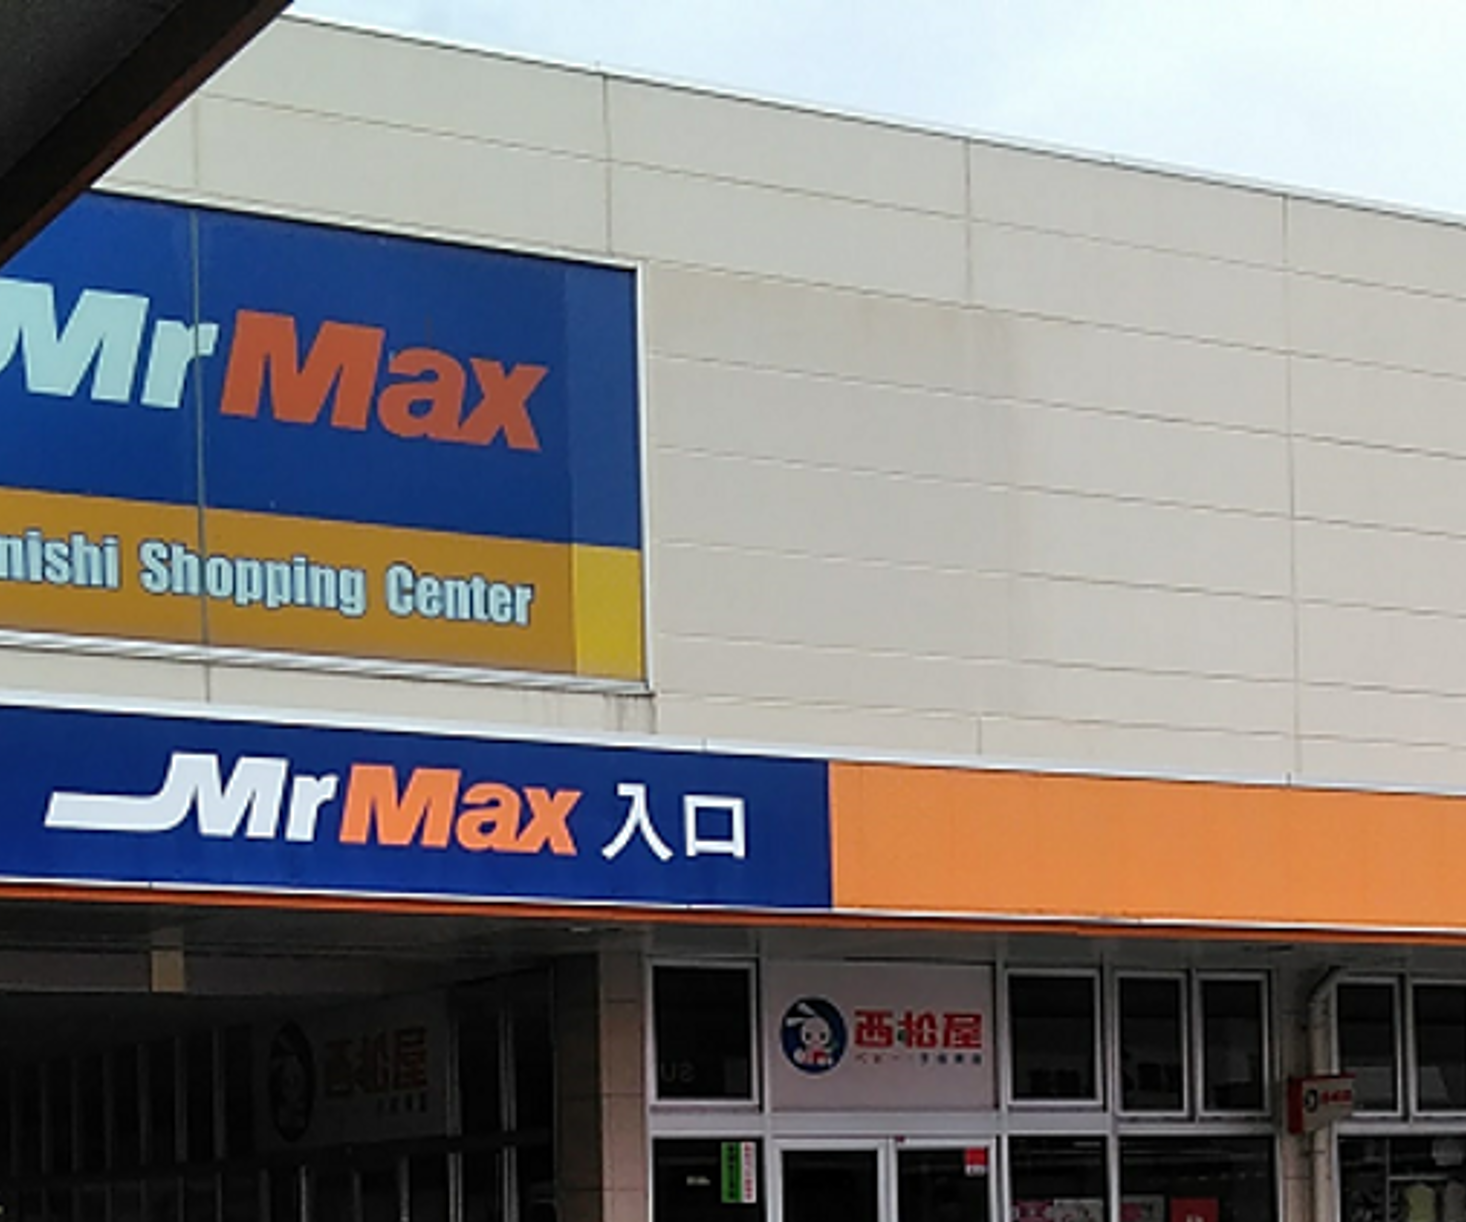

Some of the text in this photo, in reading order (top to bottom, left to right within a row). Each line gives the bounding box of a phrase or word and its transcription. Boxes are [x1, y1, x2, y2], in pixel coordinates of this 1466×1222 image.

[138, 539, 368, 618] Shopping
[384, 564, 534, 627] Center
[601, 783, 746, 862] 入口
[854, 1010, 983, 1049] 西松屋
